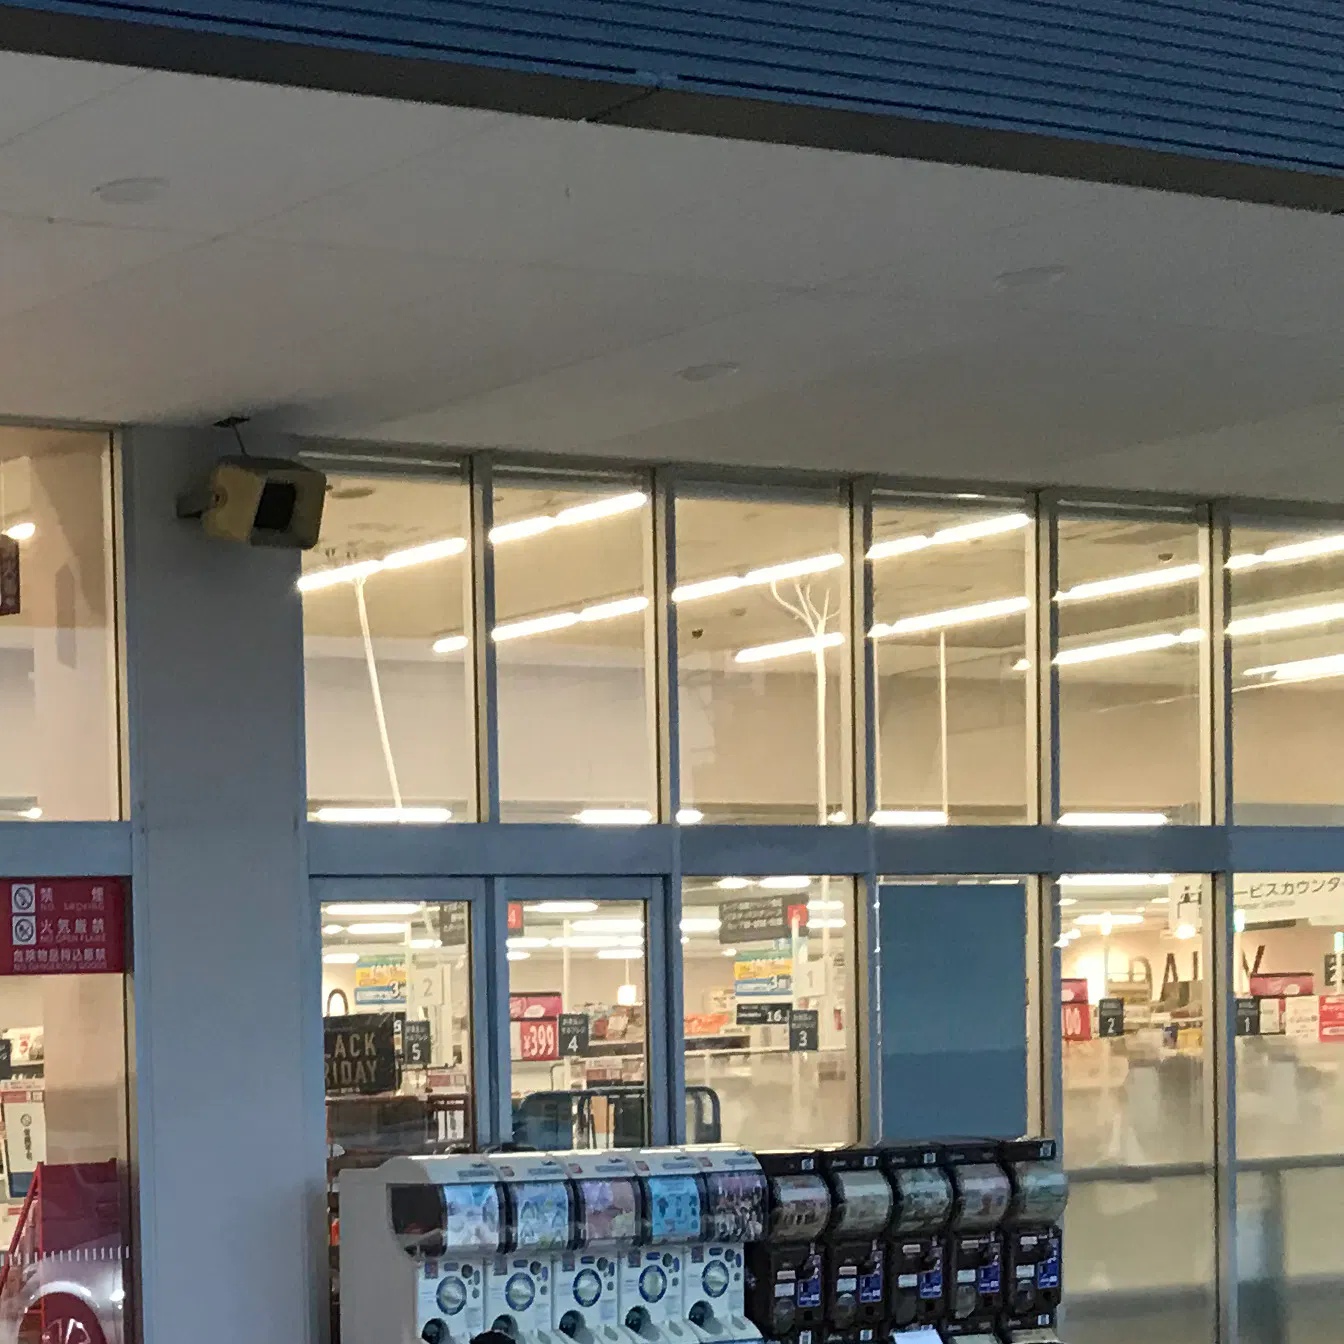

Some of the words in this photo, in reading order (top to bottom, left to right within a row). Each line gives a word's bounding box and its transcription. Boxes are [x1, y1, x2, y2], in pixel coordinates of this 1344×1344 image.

[39, 917, 106, 935] 火気厳禁
[567, 1035, 579, 1052] 4
[798, 1030, 809, 1047] 3
